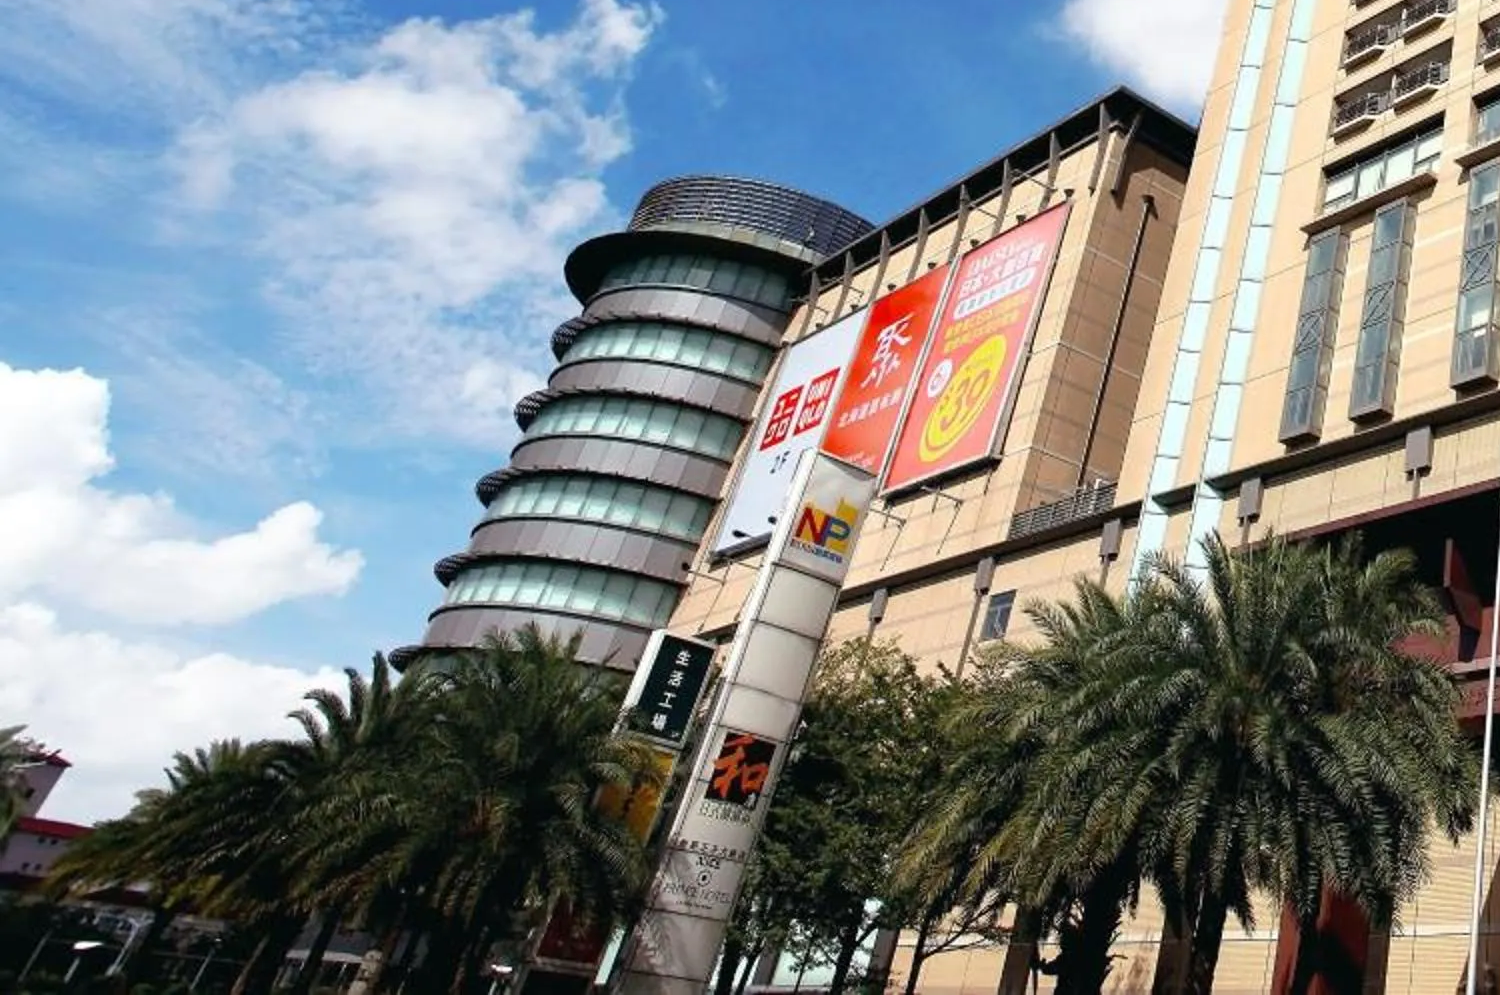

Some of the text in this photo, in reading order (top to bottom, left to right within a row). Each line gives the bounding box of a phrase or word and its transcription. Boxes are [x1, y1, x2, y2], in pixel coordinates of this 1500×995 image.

[796, 507, 851, 546] NP
[651, 649, 692, 731] 生活工場
[714, 734, 769, 798] 和
